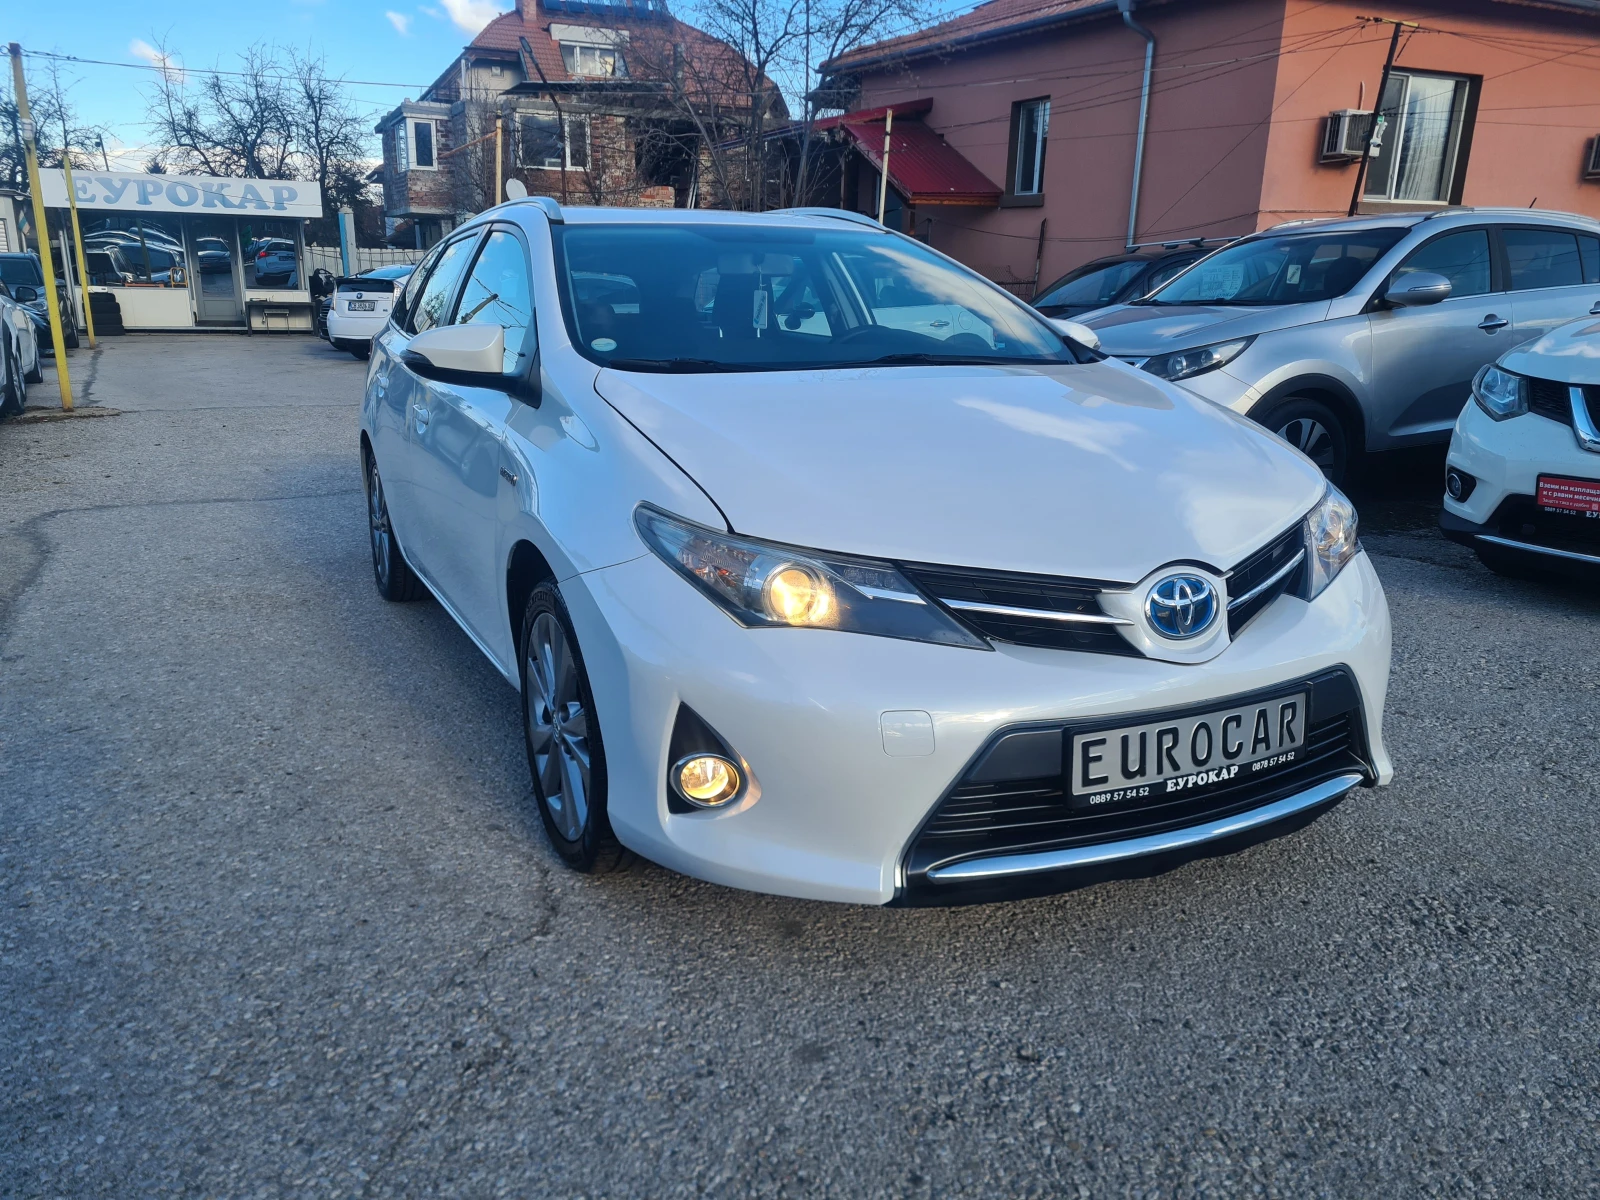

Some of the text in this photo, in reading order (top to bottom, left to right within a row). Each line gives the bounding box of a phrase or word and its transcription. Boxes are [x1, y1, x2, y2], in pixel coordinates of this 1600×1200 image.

[65, 175, 299, 211] ЕУРОКАР
[1081, 701, 1297, 788] EUROCAR
[1252, 751, 1295, 771] 0878 57 54 52
[1165, 765, 1239, 793] ЕУРОКАР
[1089, 786, 1150, 805] 0889 57 54 52
